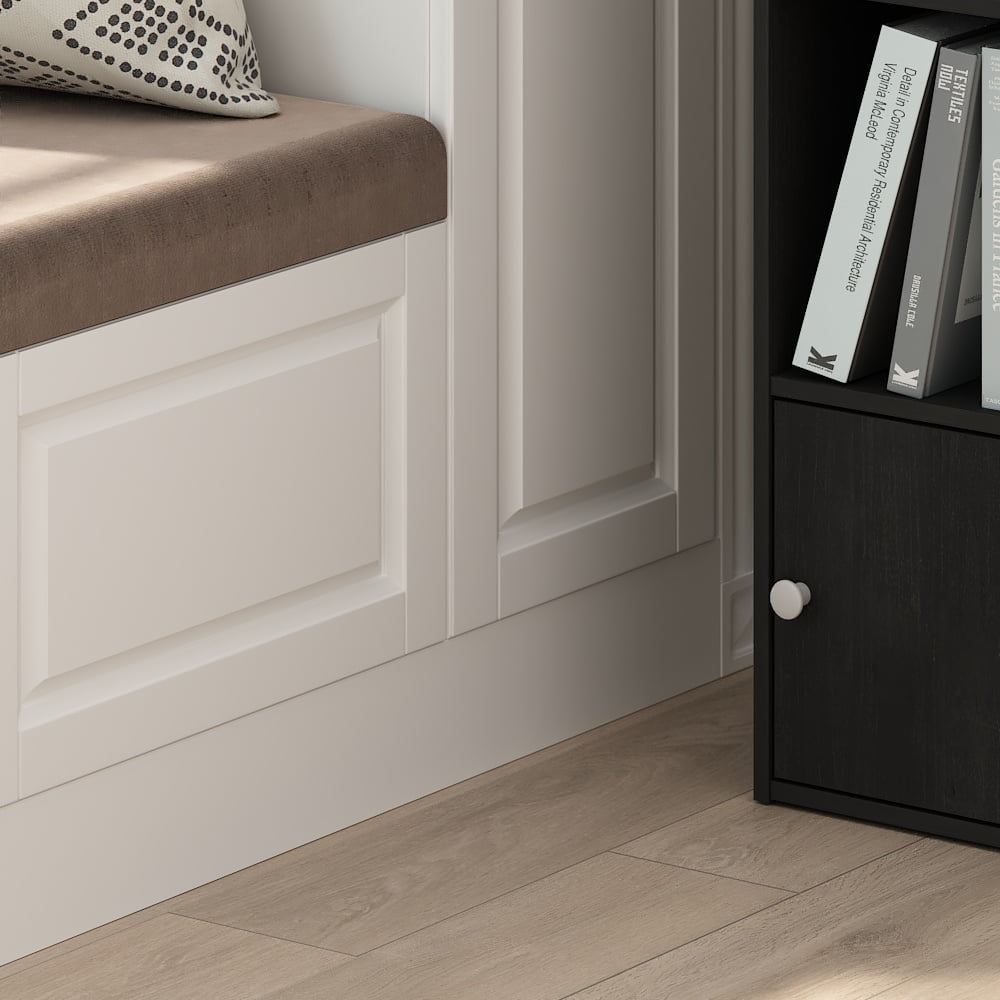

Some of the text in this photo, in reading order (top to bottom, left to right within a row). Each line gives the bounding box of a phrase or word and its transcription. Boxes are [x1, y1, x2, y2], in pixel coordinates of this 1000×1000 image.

[865, 63, 898, 141] Virginia McLeod
[899, 66, 917, 98] Detail
[947, 69, 969, 124] TEXTILES
[874, 109, 906, 178] Contemporary
[861, 178, 887, 235] Residential
[845, 233, 872, 293] Architecture
[905, 274, 922, 329] DRUSILLA COLE
[807, 345, 837, 371] K
[892, 362, 920, 386] K
